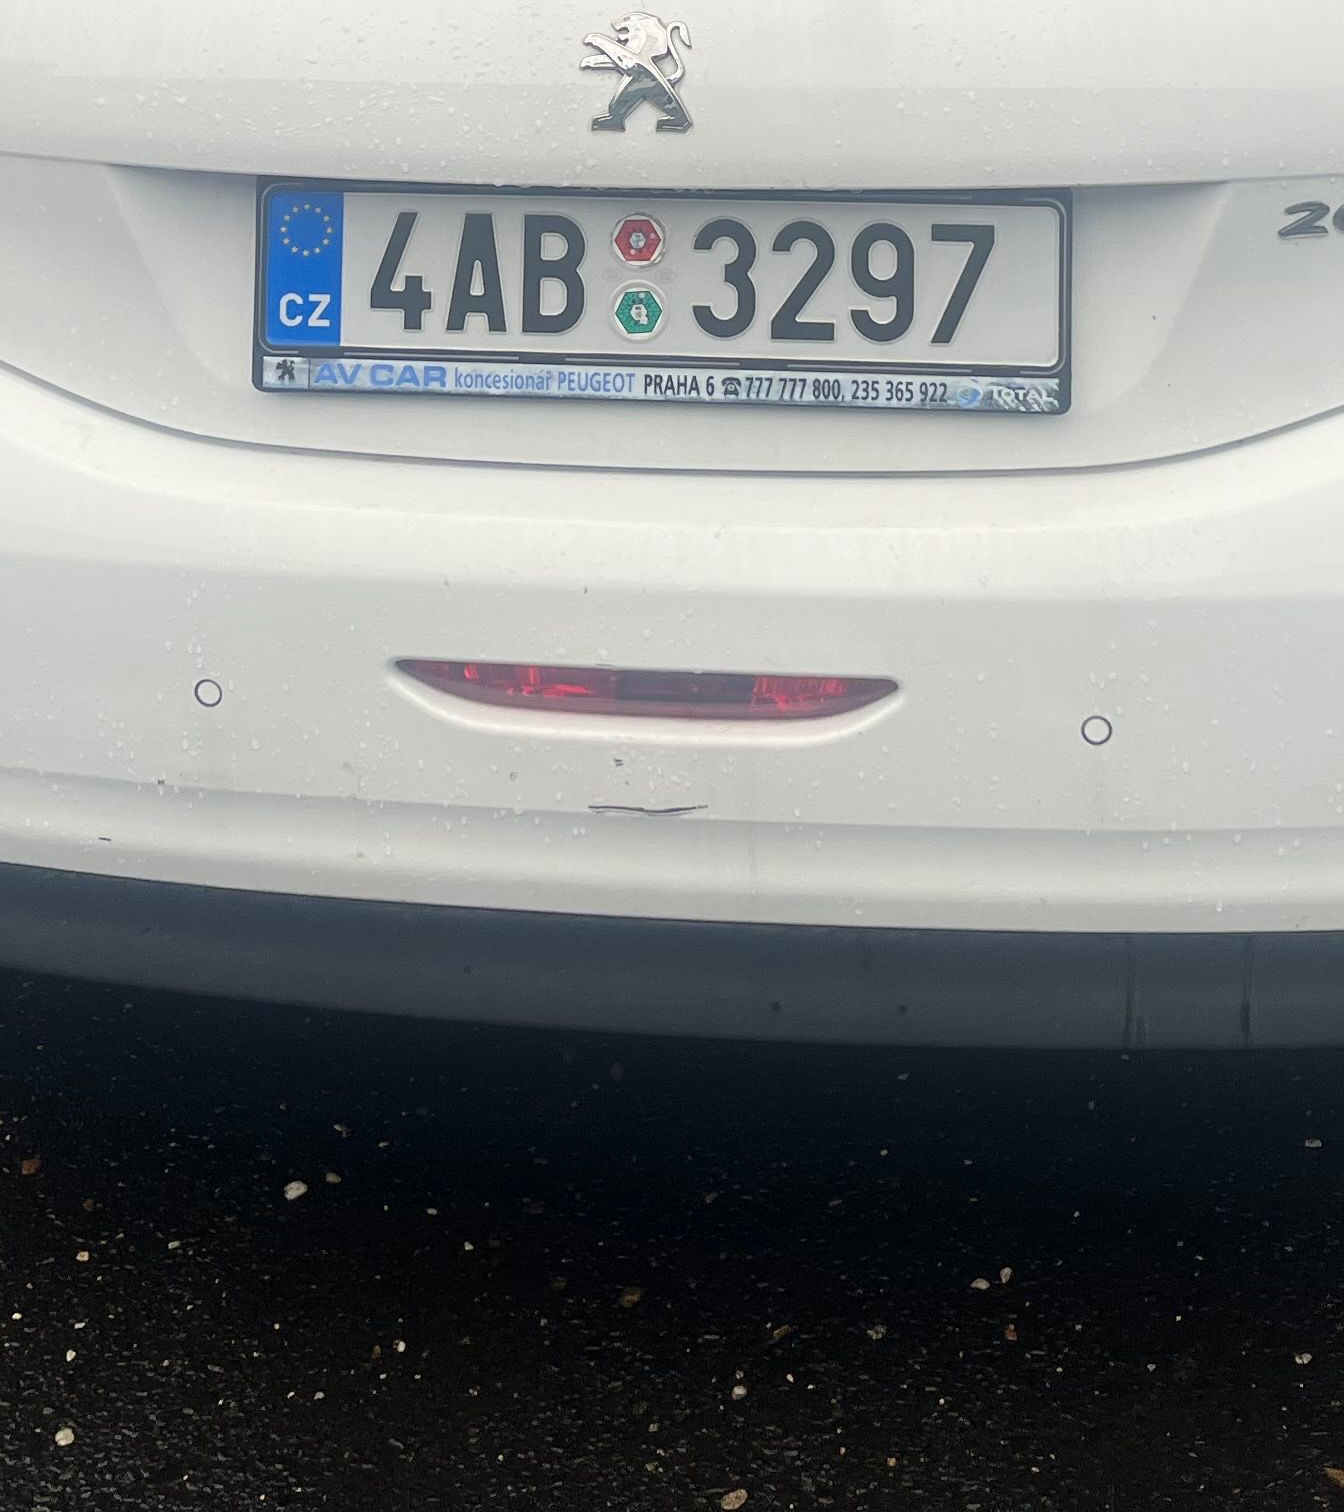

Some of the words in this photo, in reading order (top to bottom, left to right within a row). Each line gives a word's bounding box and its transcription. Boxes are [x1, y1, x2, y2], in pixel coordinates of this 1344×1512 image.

[370, 211, 586, 334] 4AB
[691, 217, 995, 344] 3297
[279, 292, 331, 328] CZ
[313, 362, 363, 385] AV
[369, 364, 447, 387] CAR
[455, 367, 553, 392] koncesionář
[557, 370, 635, 394] PEUGEOT
[643, 373, 700, 396] PRAHA
[705, 375, 716, 397] 6
[745, 376, 774, 399] 777
[779, 377, 807, 400] 777
[812, 377, 846, 403] 800,
[851, 378, 880, 402] 235
[885, 380, 914, 403] 365
[919, 381, 948, 404] 922
